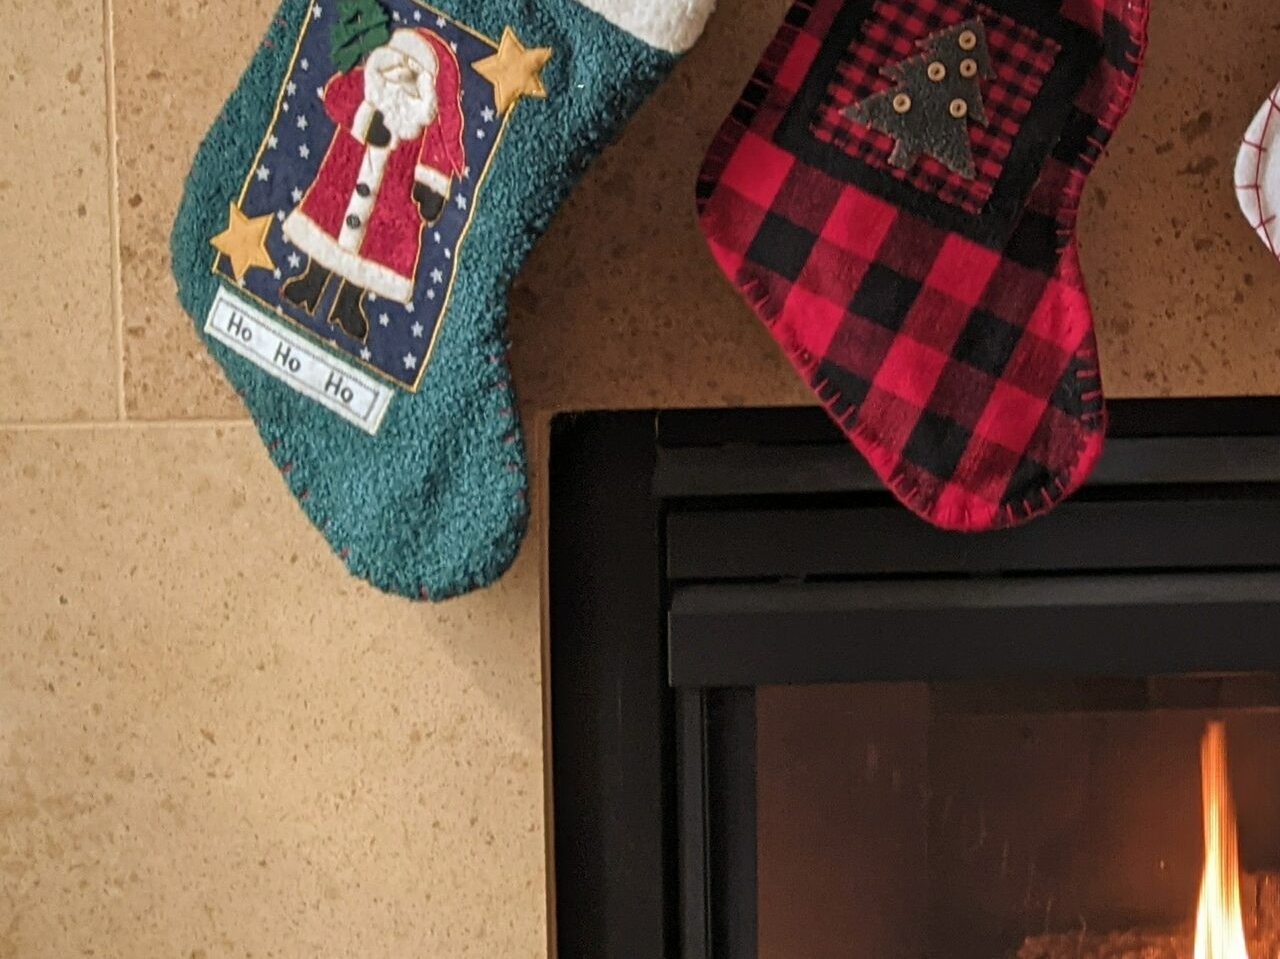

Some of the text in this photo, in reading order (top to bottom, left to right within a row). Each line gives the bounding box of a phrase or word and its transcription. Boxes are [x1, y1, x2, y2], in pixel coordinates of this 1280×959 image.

[226, 311, 354, 404] Ho Ho Ho
